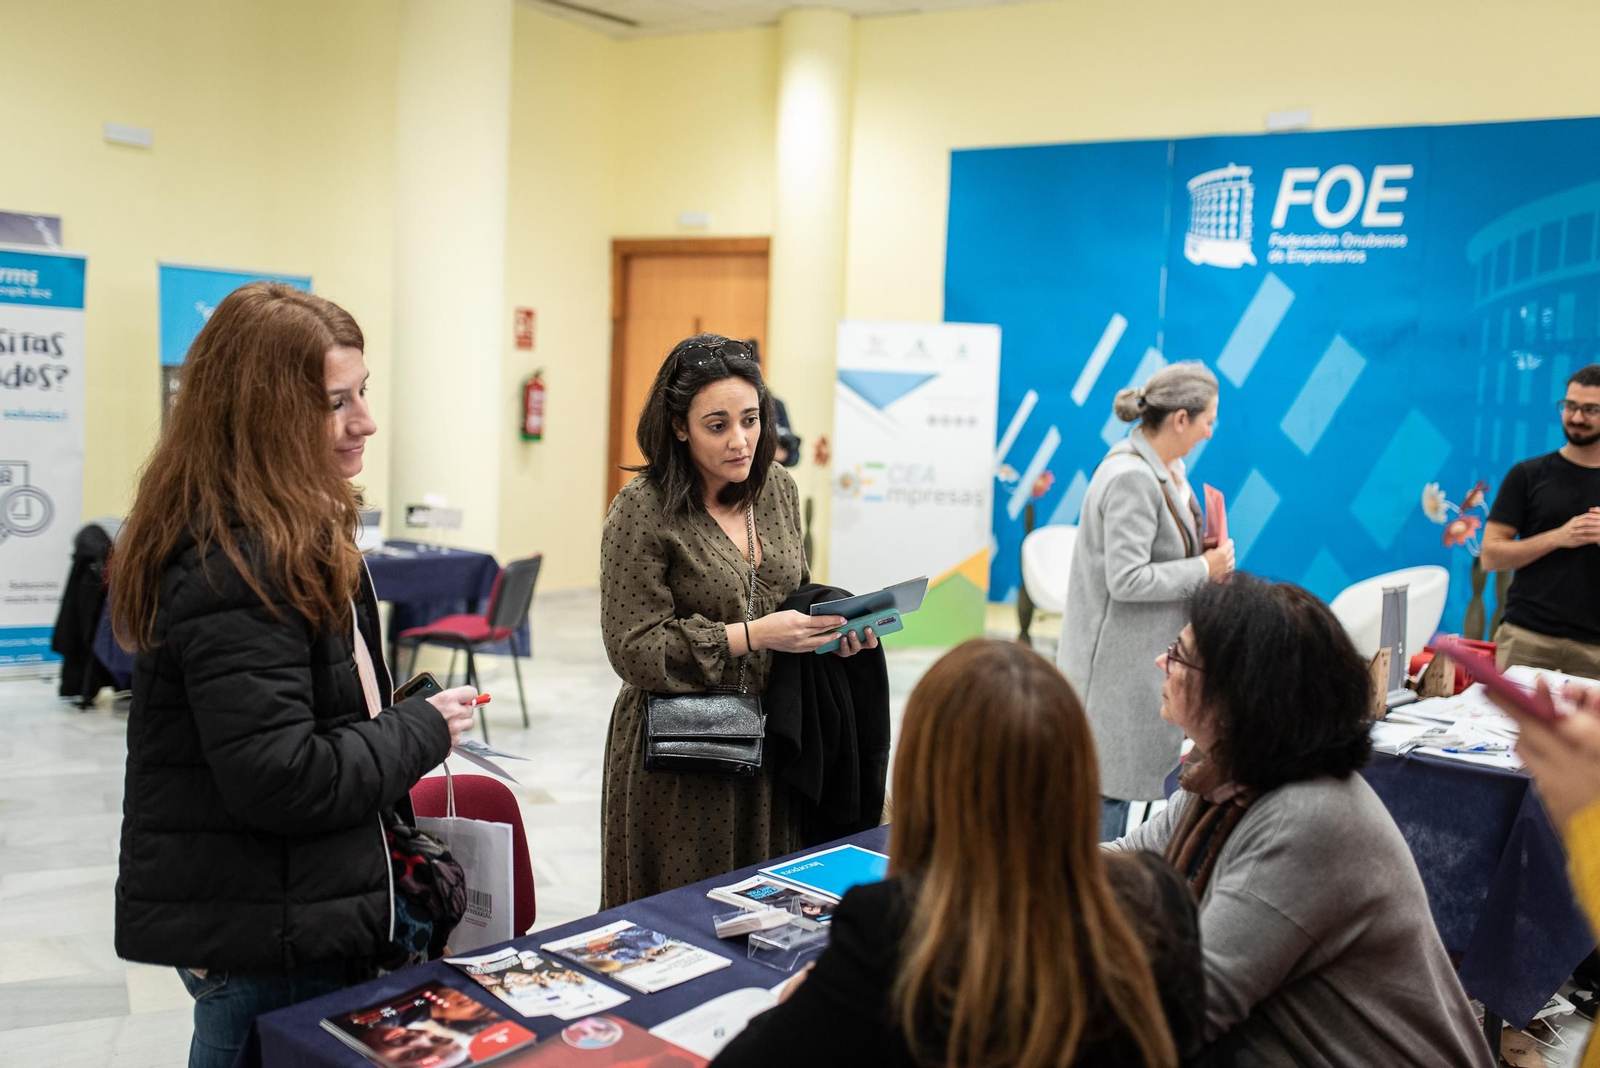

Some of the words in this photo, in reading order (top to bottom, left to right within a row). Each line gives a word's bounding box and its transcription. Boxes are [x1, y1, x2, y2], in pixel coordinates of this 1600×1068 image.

[1270, 163, 1414, 229] FOE
[1268, 231, 1339, 248] Federación
[1341, 231, 1408, 248] Onubense
[1267, 249, 1284, 264] de
[1286, 248, 1367, 266] Empresarios
